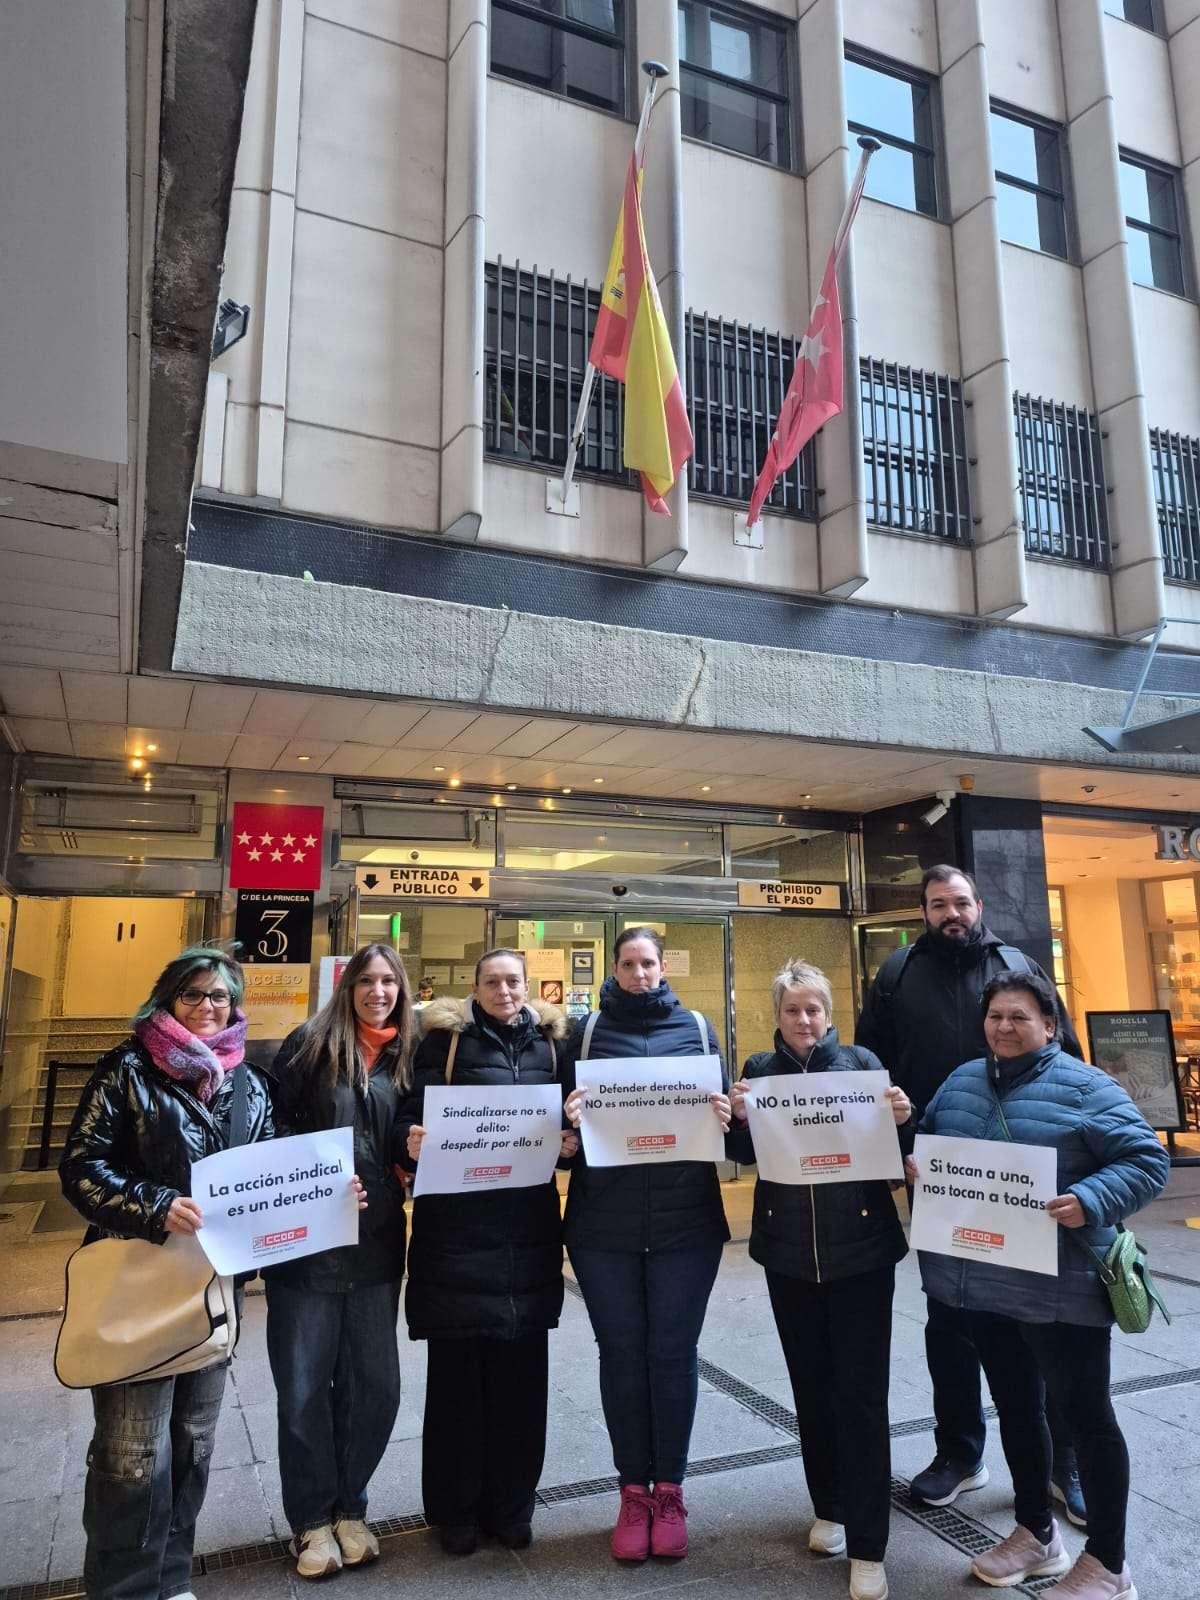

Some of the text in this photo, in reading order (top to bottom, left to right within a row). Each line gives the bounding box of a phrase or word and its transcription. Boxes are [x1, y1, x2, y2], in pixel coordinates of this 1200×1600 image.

[390, 869, 460, 882] ENTRADA
[393, 881, 458, 895] PÚBLICO
[760, 883, 822, 895] PROHIBIDO
[767, 895, 814, 905] EL PASO
[258, 909, 290, 957] 3
[599, 1081, 697, 1094] Defender derechos
[585, 1099, 603, 1109] NO
[604, 1100, 617, 1108] es
[619, 1096, 656, 1108] motivo
[658, 1096, 671, 1106] de
[756, 1091, 875, 1109] NO a la represión
[442, 1106, 547, 1118] Sindicalizarse no es
[792, 1110, 844, 1126] sindical
[476, 1121, 510, 1133] delito:
[440, 1137, 490, 1152] despedir
[491, 1139, 510, 1150] por
[513, 1137, 532, 1148] ello
[209, 1158, 343, 1198] La acción sindical
[930, 1158, 1034, 1187] Si tocan a una,
[227, 1185, 333, 1217] es un derecho
[923, 1182, 1045, 1210] nos tocan a todas
